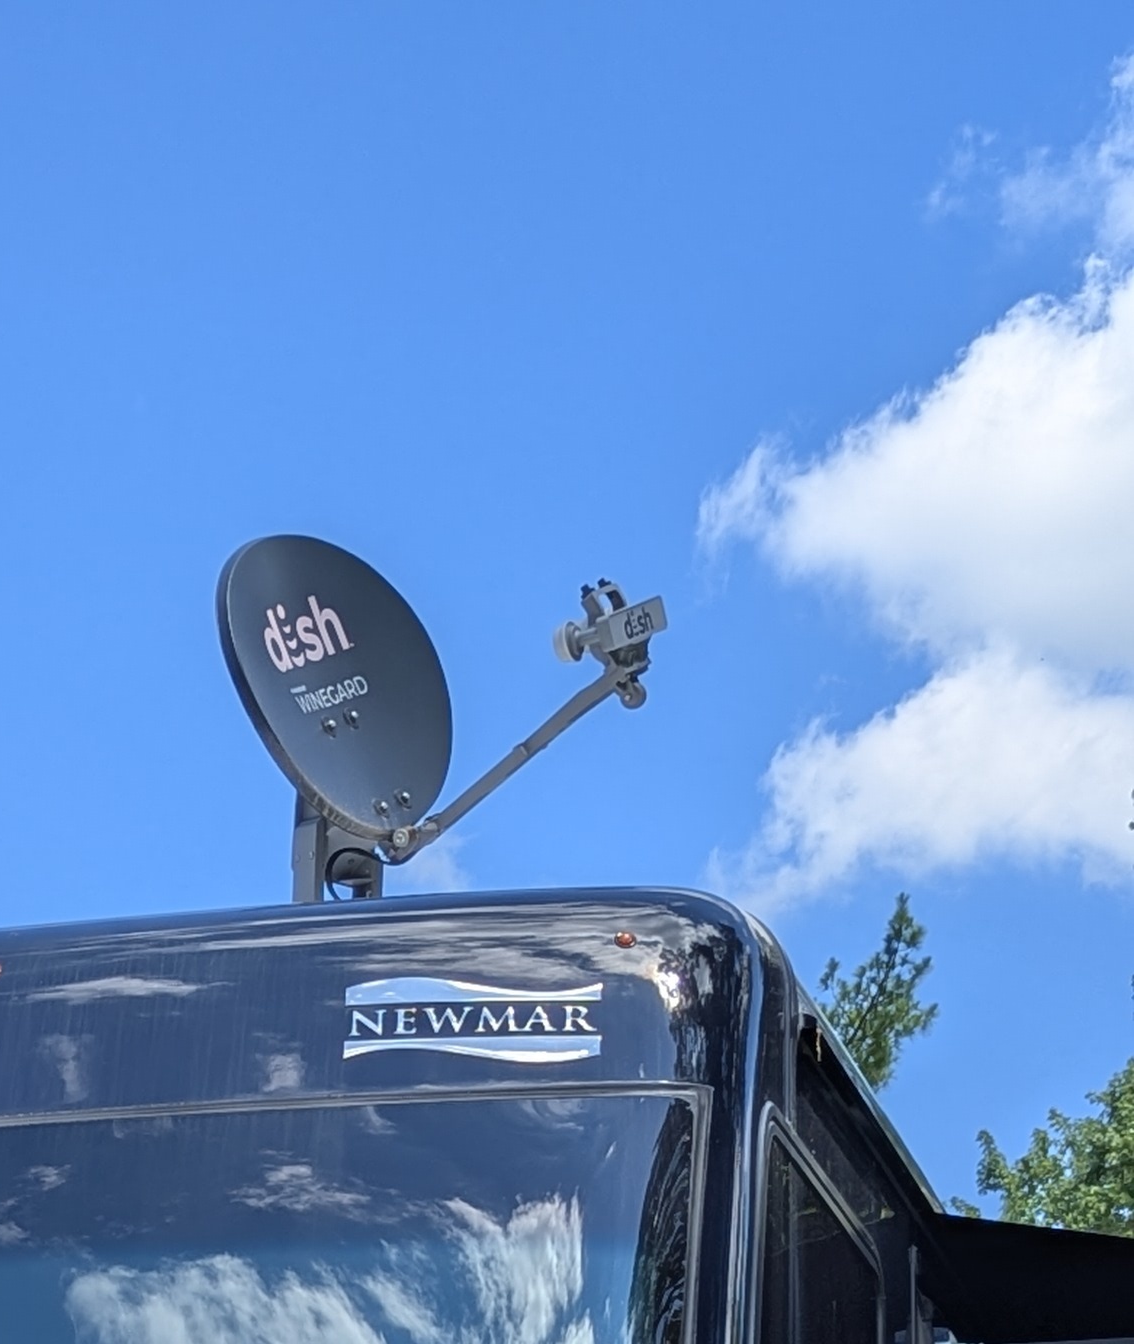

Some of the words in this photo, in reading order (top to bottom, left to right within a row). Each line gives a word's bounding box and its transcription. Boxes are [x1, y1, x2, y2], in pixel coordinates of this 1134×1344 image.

[264, 595, 350, 673] dish
[624, 606, 654, 640] dish
[294, 675, 369, 714] WINEGARD
[348, 1005, 597, 1036] NEWMAR
